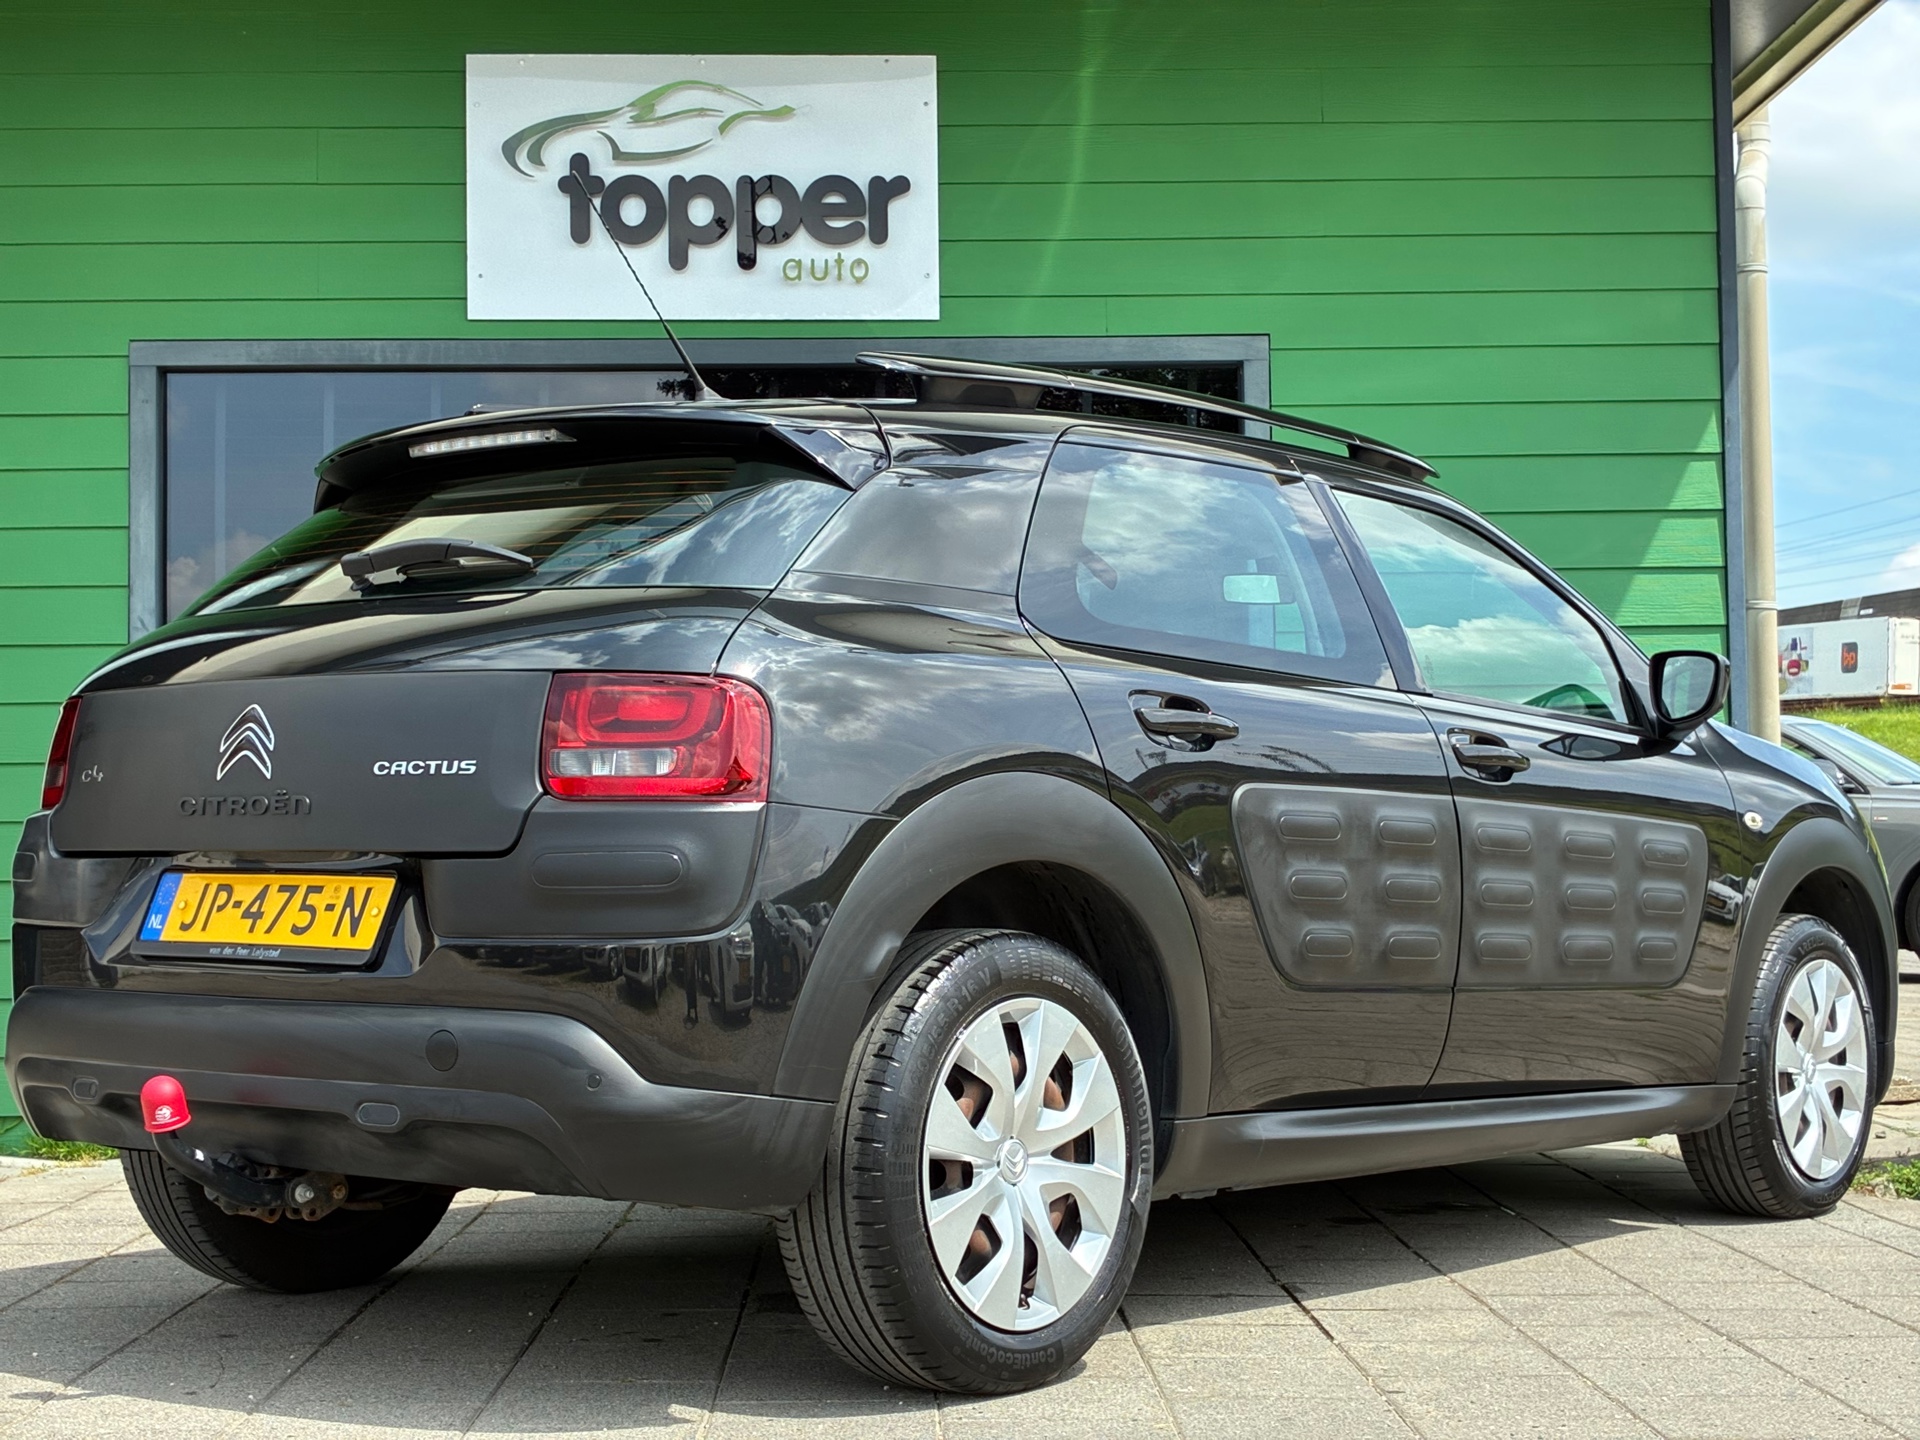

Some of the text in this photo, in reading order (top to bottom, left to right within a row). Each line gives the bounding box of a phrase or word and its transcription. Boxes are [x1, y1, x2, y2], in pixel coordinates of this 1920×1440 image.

[557, 152, 911, 271] topper
[782, 252, 869, 283] auto
[373, 759, 477, 775] CACTUS
[147, 914, 163, 929] NL
[179, 883, 374, 938] JP-475-N
[209, 946, 281, 959] van der Feer Lelystad
[1111, 1018, 1151, 1175] Continental
